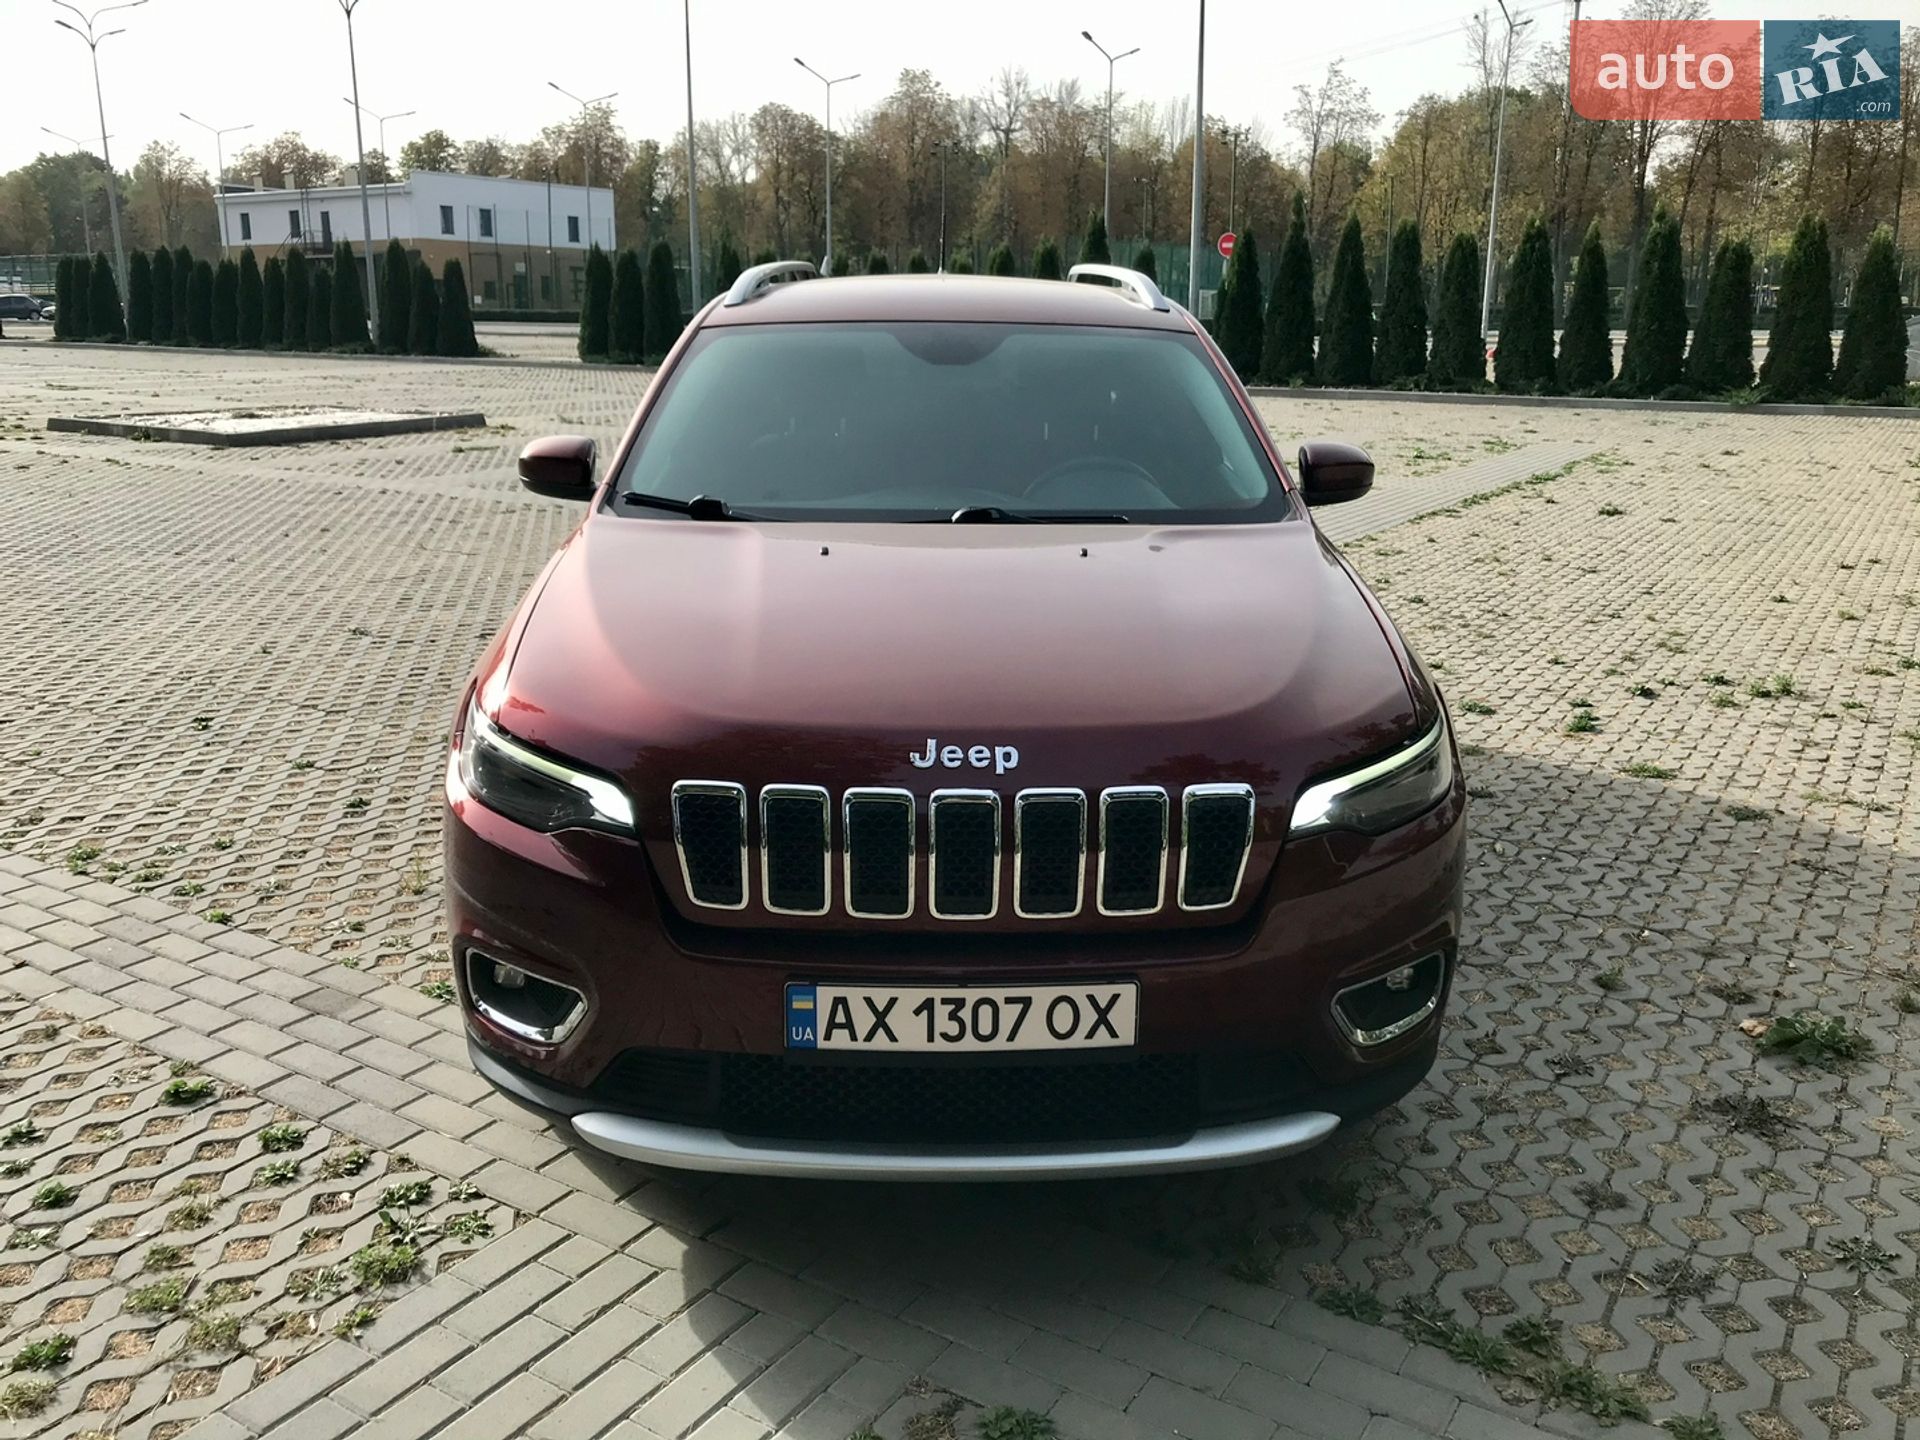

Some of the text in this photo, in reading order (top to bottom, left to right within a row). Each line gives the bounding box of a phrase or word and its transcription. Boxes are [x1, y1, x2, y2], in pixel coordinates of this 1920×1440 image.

[909, 738, 1019, 775] Jeep
[791, 1026, 815, 1041] UA
[822, 993, 1122, 1043] AX 1307 OX
